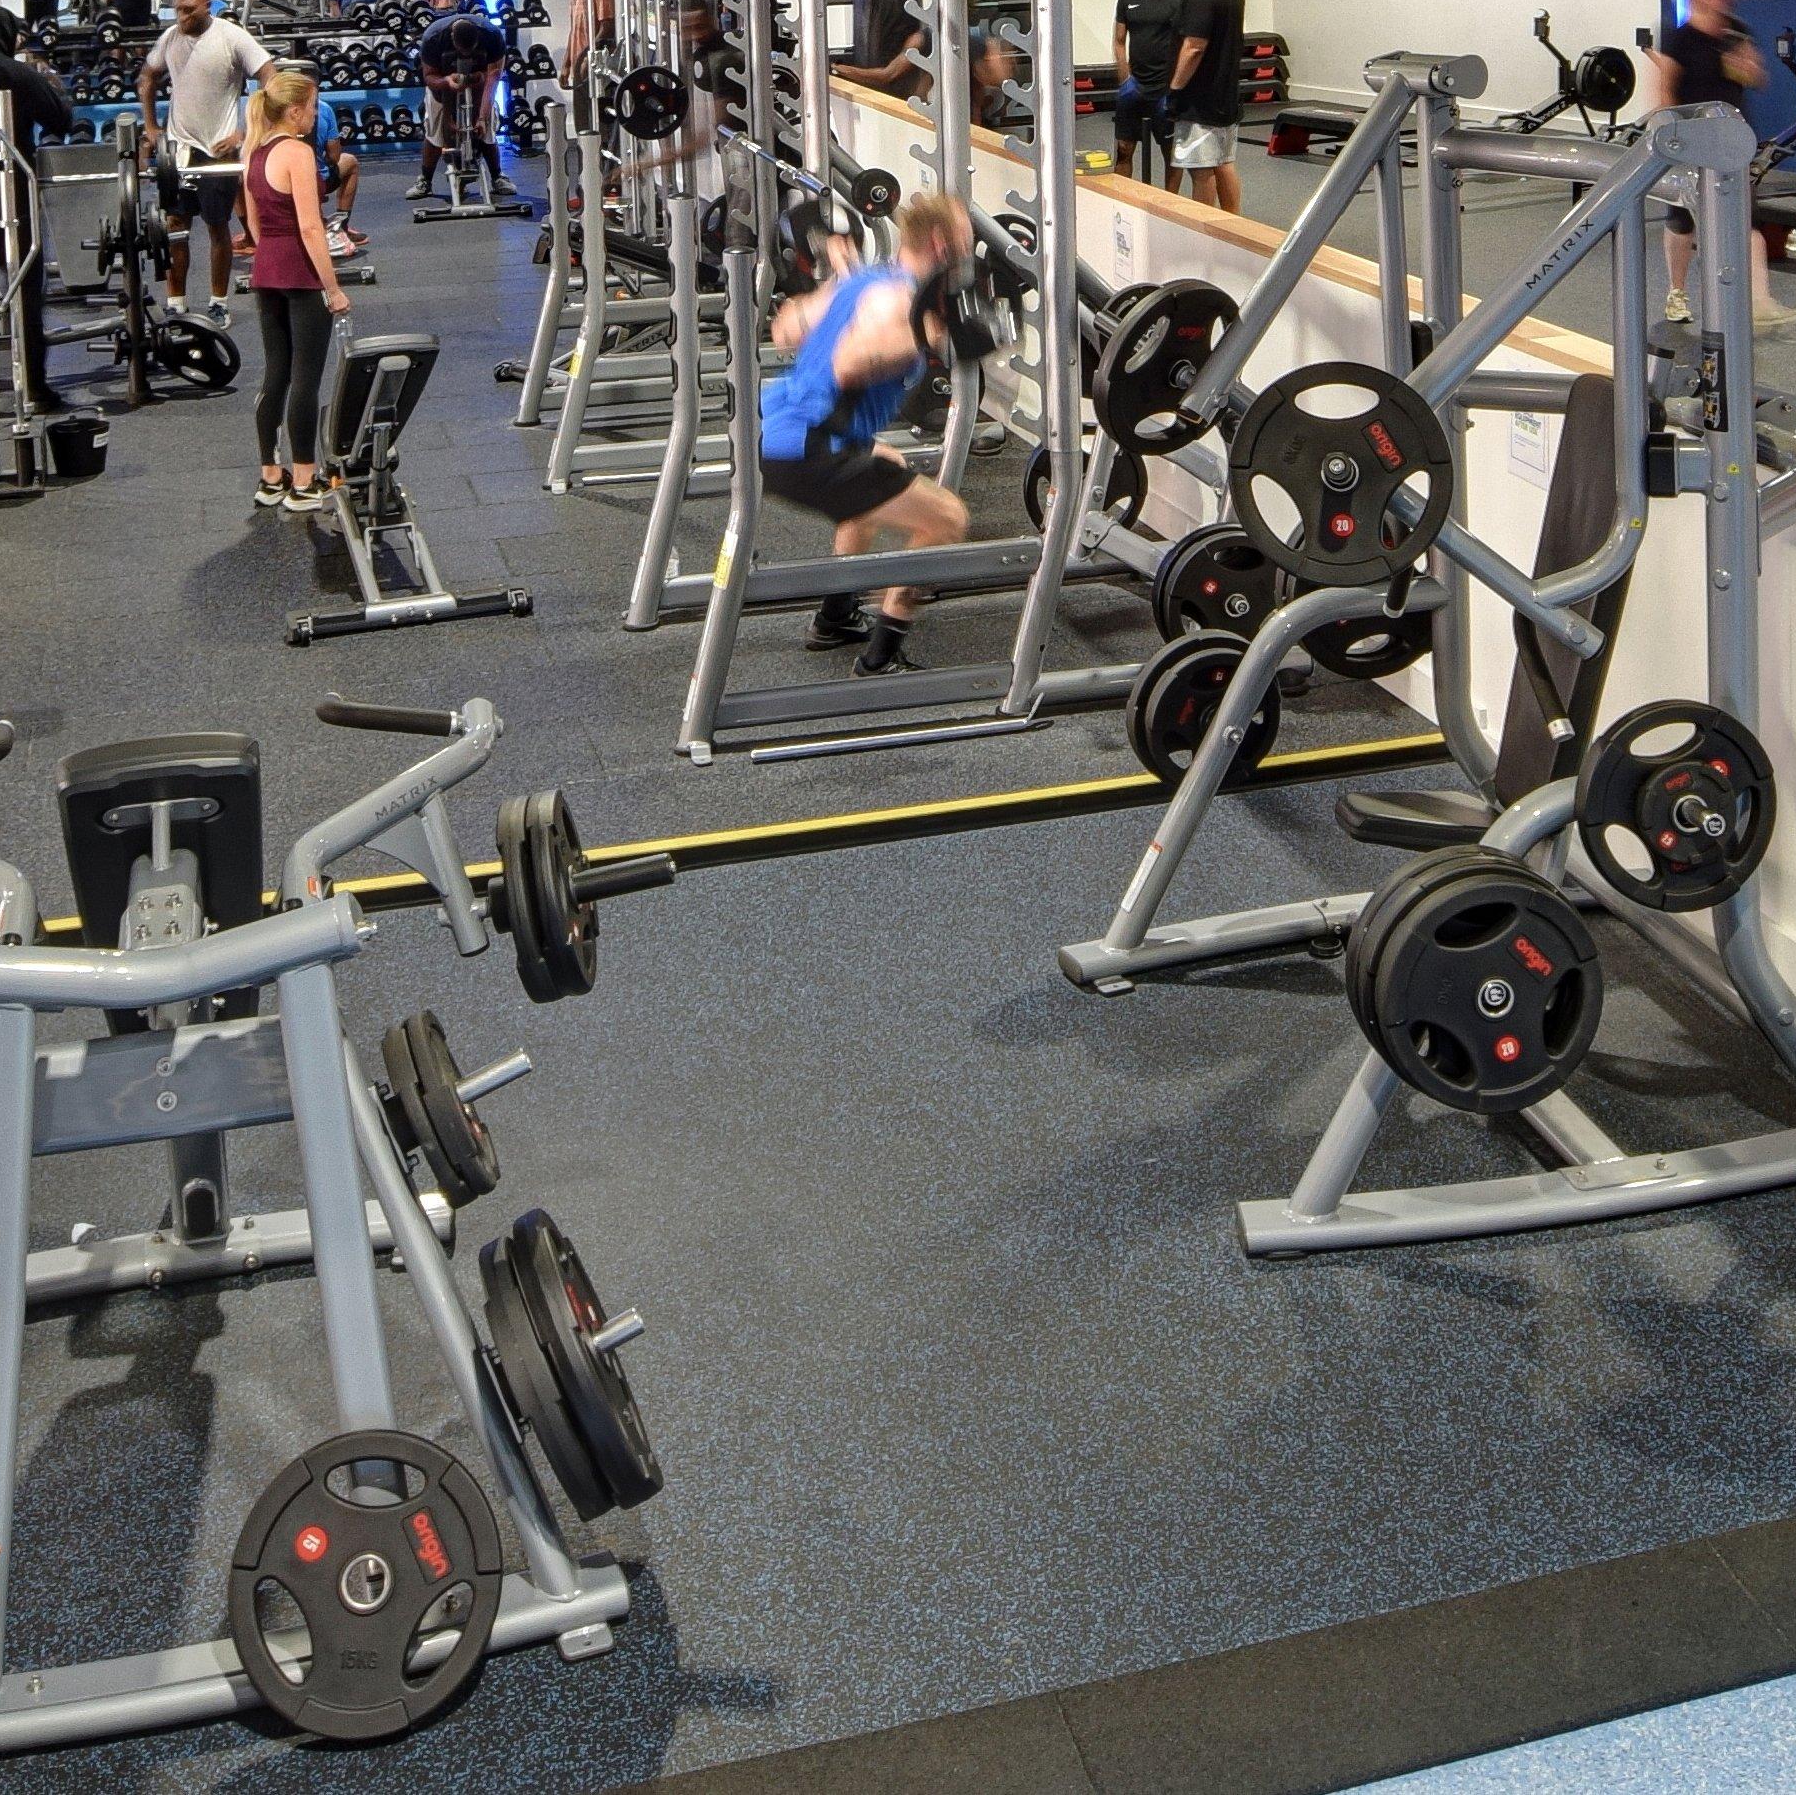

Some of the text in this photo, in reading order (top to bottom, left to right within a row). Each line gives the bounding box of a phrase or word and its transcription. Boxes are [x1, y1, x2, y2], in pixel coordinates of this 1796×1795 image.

[1524, 218, 1596, 291] MATRIX
[1368, 421, 1402, 466] origin
[1335, 518, 1349, 532] 20
[373, 774, 439, 822] MATRIX
[1513, 935, 1553, 976] origin
[302, 1533, 321, 1554] 15
[409, 1509, 450, 1578] origin
